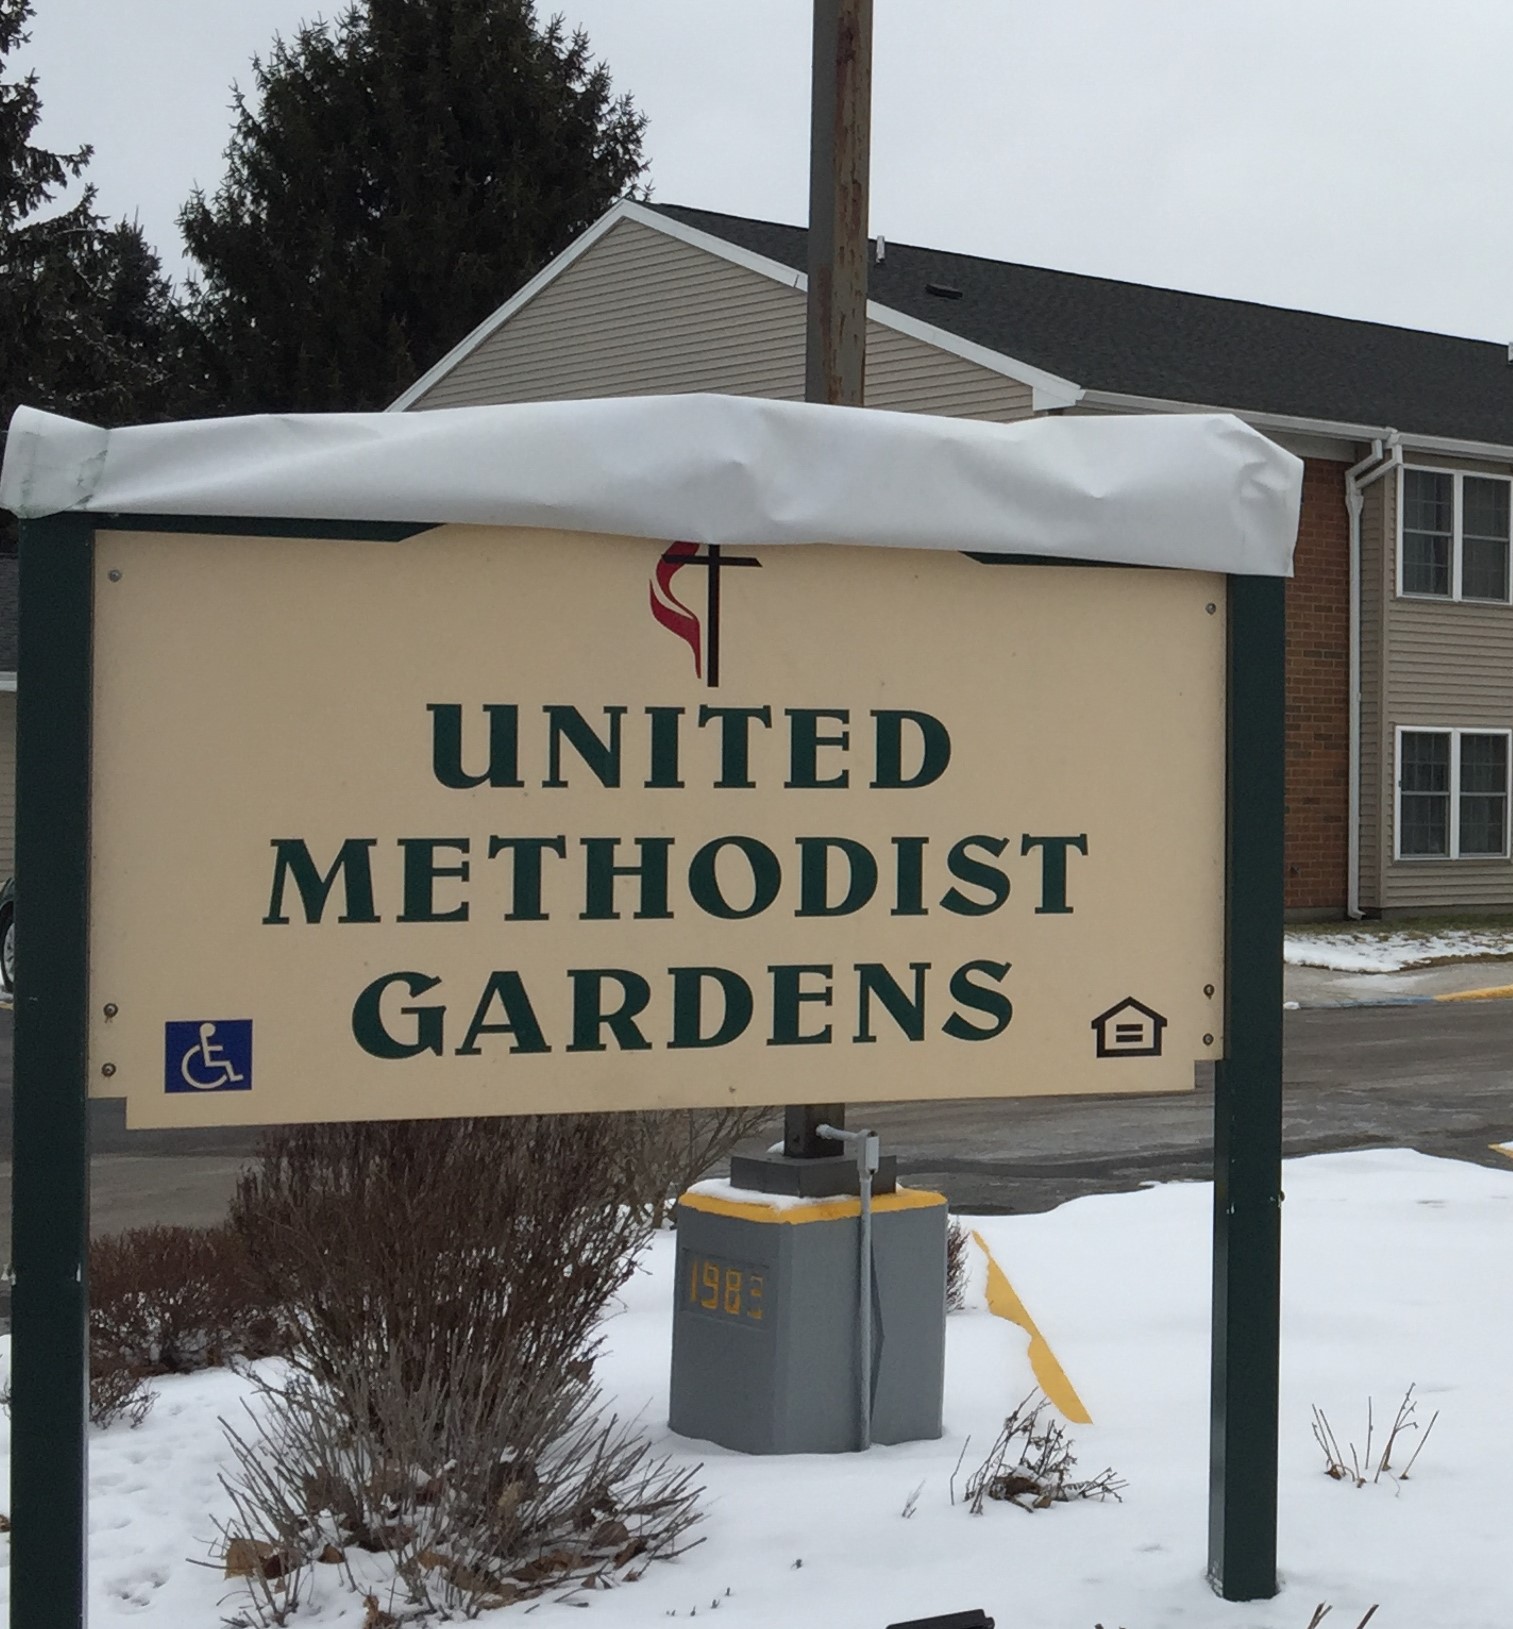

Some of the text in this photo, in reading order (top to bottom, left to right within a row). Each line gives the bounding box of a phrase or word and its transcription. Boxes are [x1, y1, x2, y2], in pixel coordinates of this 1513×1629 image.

[426, 703, 951, 790] UNITED
[262, 833, 1088, 925] METHODIST
[351, 959, 1013, 1060] GARDENS
